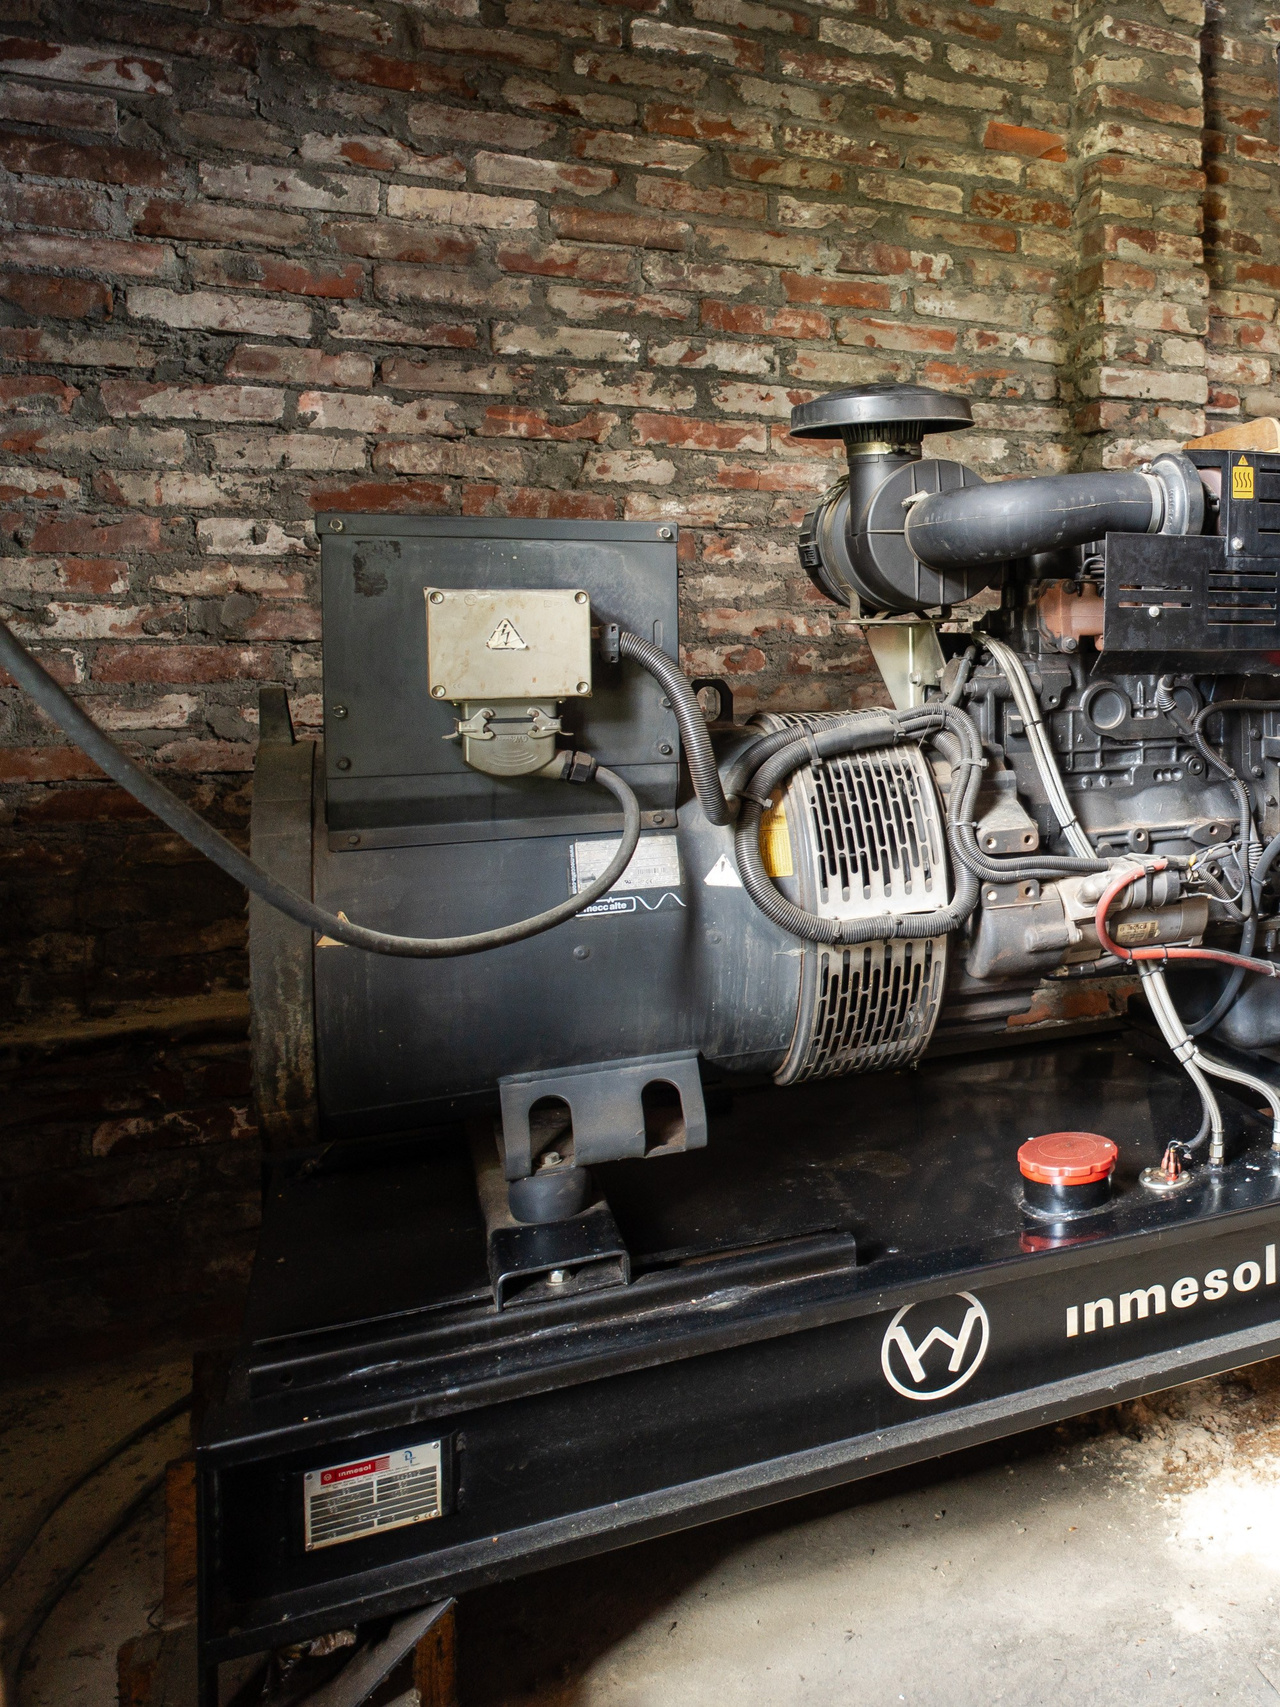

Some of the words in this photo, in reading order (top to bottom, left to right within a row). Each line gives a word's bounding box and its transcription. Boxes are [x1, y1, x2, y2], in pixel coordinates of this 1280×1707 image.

[609, 902, 627, 910] alte
[1066, 1243, 1277, 1339] inmesol
[338, 1464, 372, 1477] inmesol
